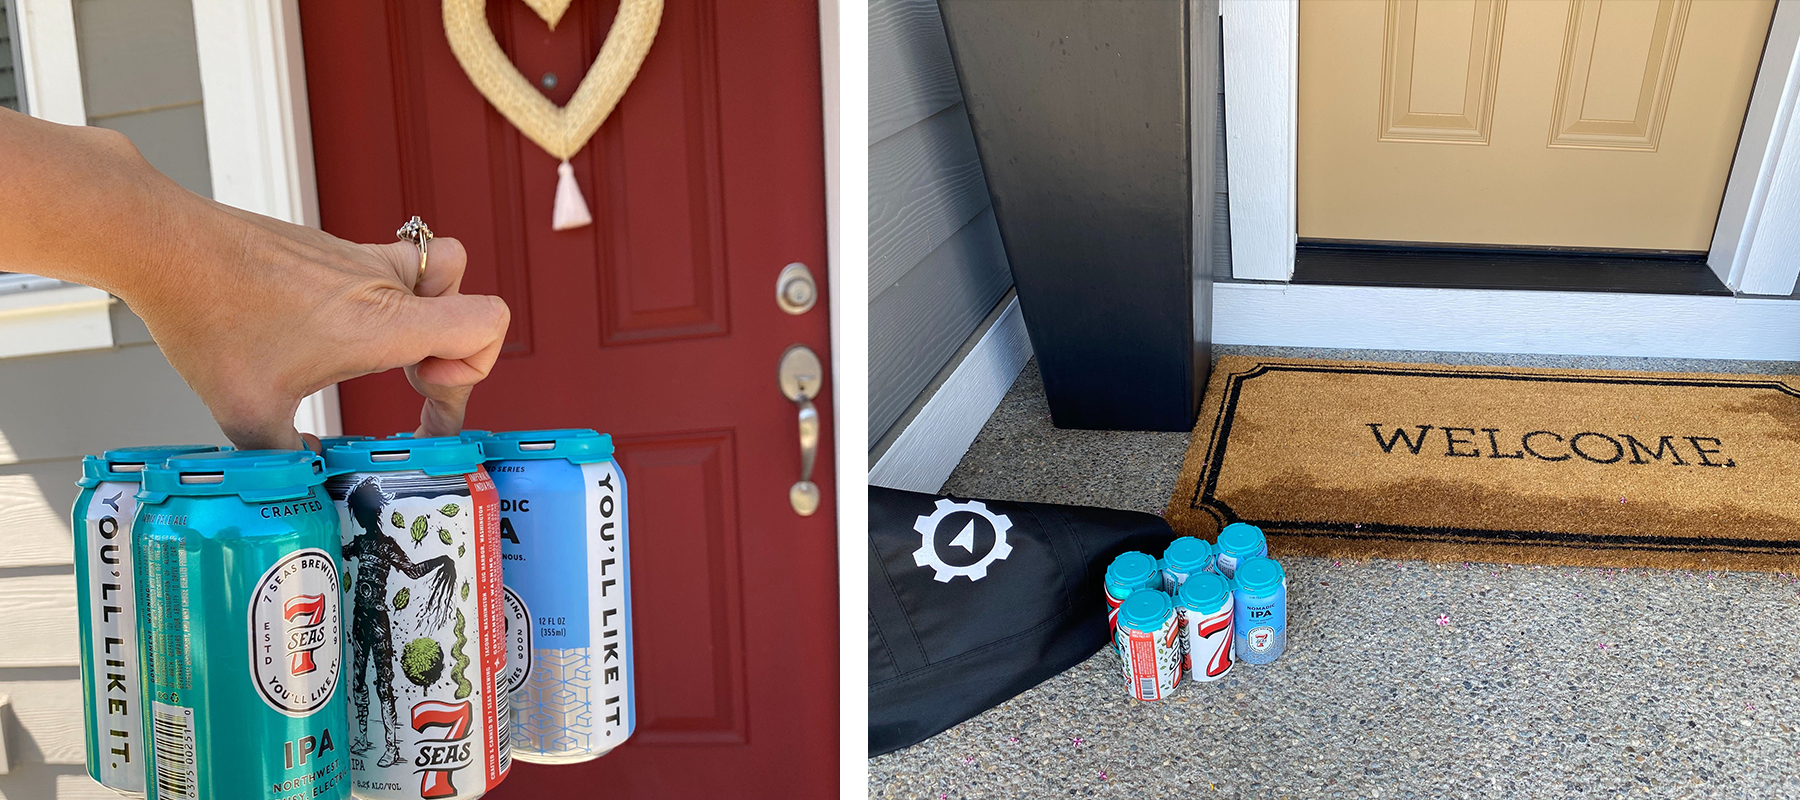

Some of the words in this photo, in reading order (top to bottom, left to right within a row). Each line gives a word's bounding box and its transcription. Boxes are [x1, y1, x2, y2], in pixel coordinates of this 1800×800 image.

[1366, 424, 1735, 467] WELCOME
[173, 515, 187, 526] ALE
[261, 501, 322, 518] CRAFTED
[598, 473, 616, 597] YOU'LL
[99, 491, 123, 622] YOU'LL
[503, 553, 526, 561] NOUS.
[263, 595, 272, 603] 7
[269, 564, 297, 592] SEAS
[301, 559, 336, 592] BREWING
[504, 594, 523, 620] WING
[539, 617, 546, 625] 12
[548, 617, 555, 625] FL
[557, 617, 566, 625] OZ
[1251, 610, 1272, 618] IPA
[283, 592, 326, 677] 7
[287, 625, 326, 651] SEAS
[541, 628, 566, 637] (355ml)
[603, 608, 619, 685] LIKE
[104, 637, 127, 715] LIKE
[269, 676, 307, 704] YOU'LL
[311, 677, 331, 702] LIKE
[330, 658, 338, 675] IT.
[508, 667, 522, 685] RIES
[488, 715, 493, 723] BY
[605, 695, 620, 737] IT.
[110, 729, 130, 768] IT.
[184, 730, 193, 764] 00251
[284, 728, 335, 770] IPA
[411, 700, 473, 799] 7
[415, 742, 471, 767] SEAS
[273, 759, 340, 793] NORTHWEST.
[351, 758, 366, 771] IPA
[372, 782, 402, 790] ALC/VOL
